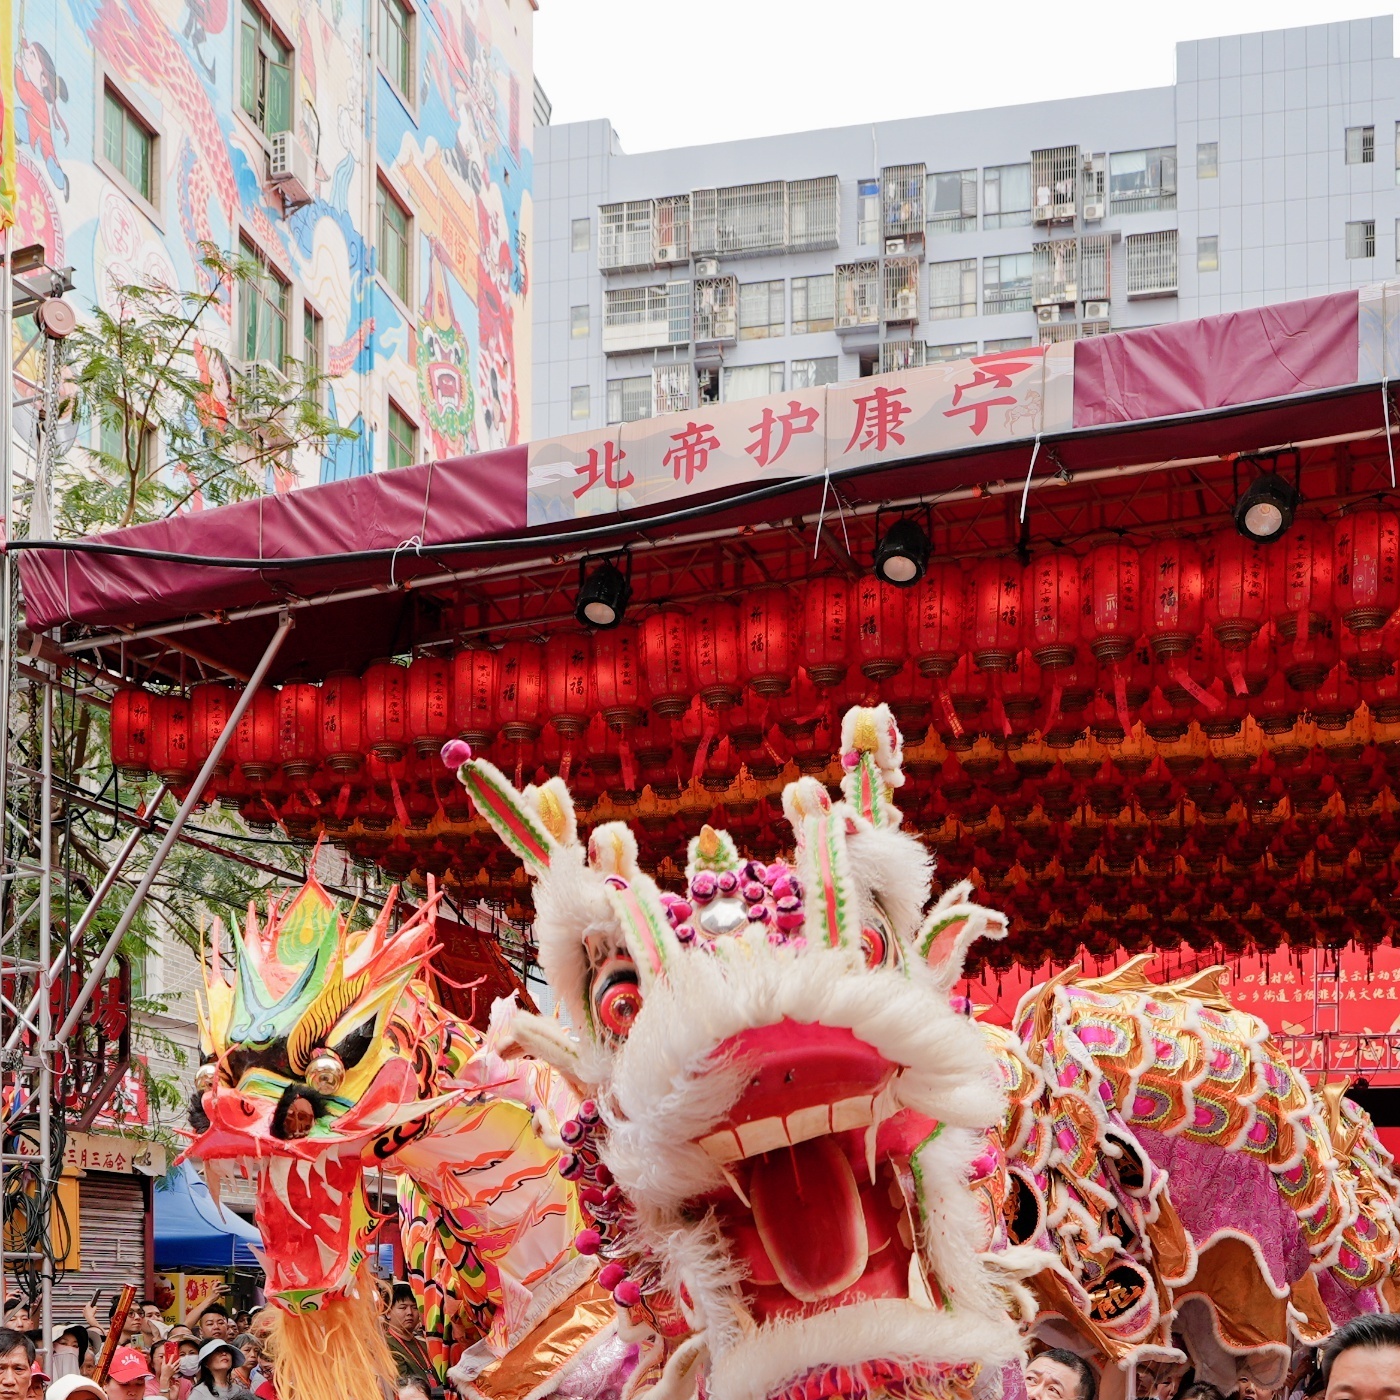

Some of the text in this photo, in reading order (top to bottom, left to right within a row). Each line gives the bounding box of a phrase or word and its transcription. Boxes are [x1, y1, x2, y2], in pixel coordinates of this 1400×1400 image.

[572, 366, 1018, 500] 北帝护康宁
[1000, 577, 1018, 628] 祈福
[1158, 557, 1177, 609] 祈福
[749, 605, 765, 653] 祈福
[862, 589, 877, 636] 祈福
[502, 658, 518, 702] 祈福
[569, 651, 586, 697] 祈福
[129, 705, 149, 745] 祈福
[171, 711, 187, 751] 祈福
